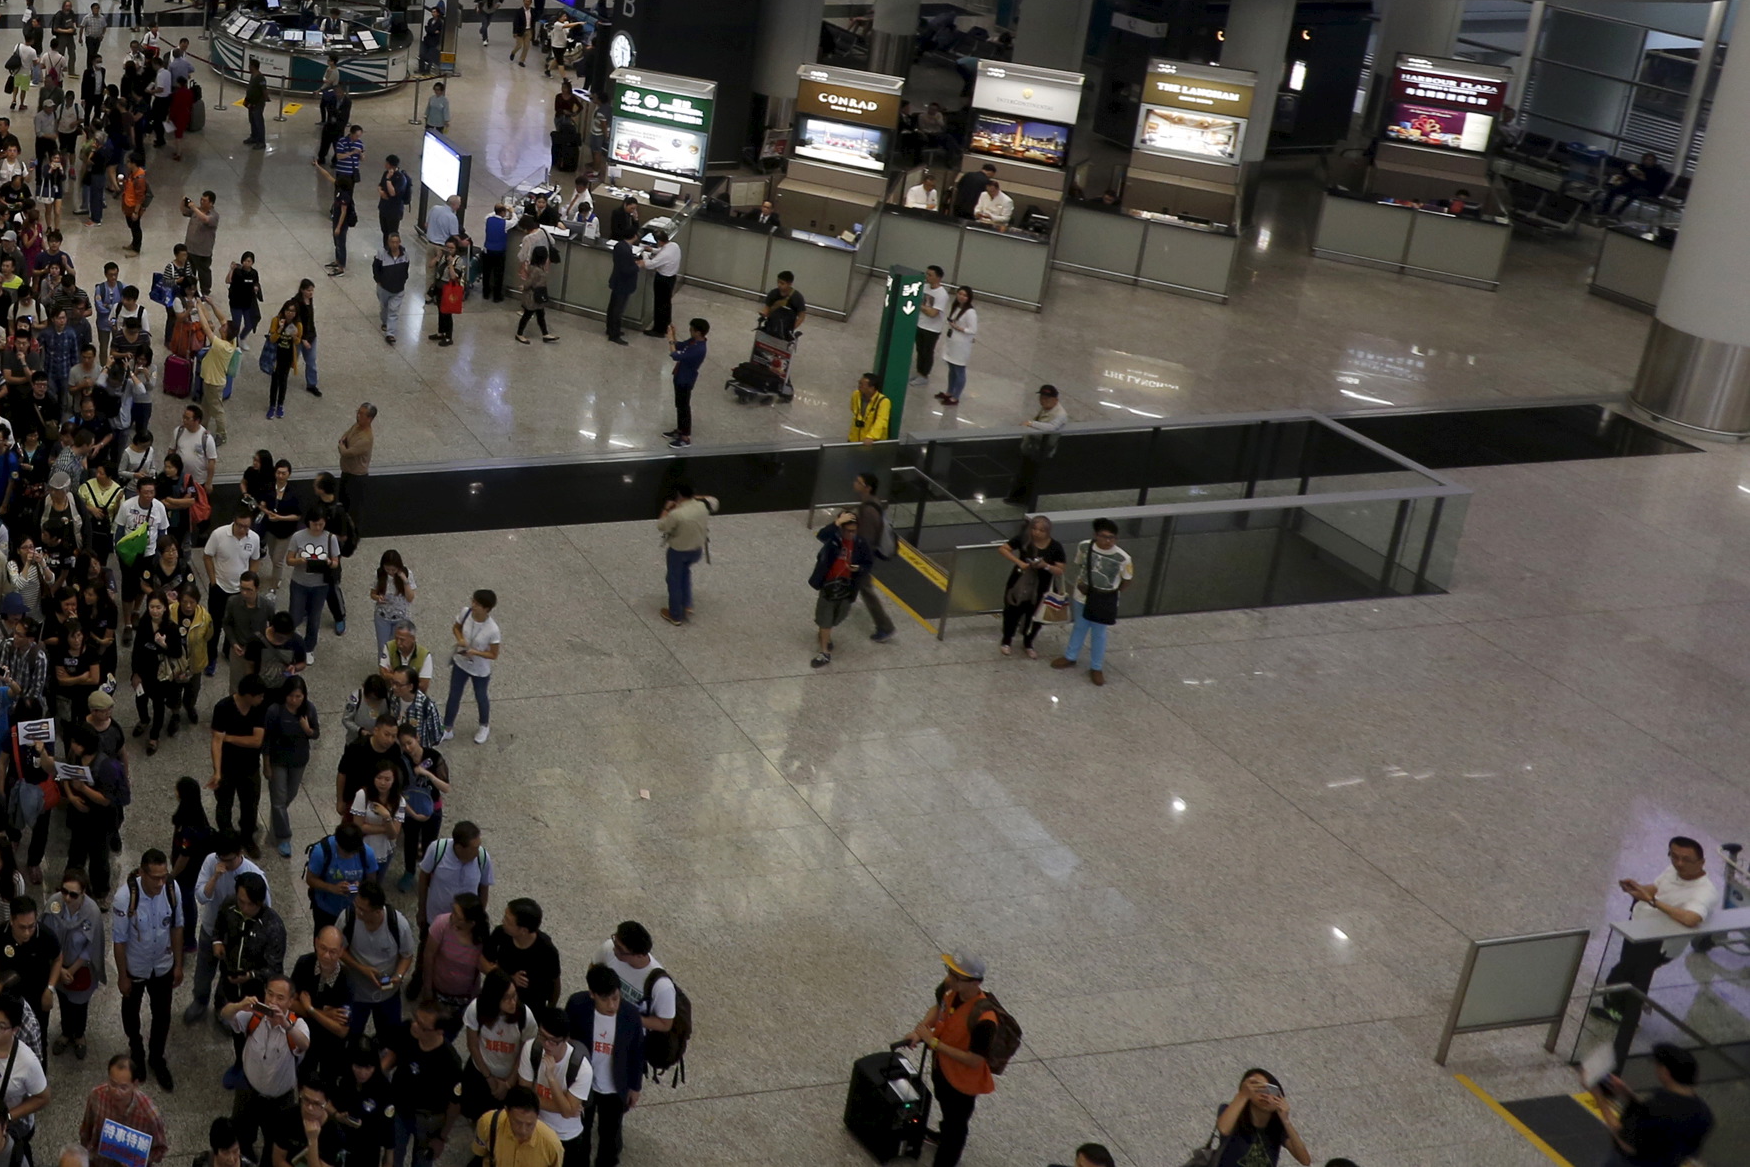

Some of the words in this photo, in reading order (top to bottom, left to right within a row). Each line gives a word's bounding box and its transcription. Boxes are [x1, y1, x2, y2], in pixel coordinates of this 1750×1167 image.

[1157, 81, 1181, 93] THE
[1181, 85, 1240, 101] LANGHAM
[1401, 73, 1458, 87] HARBOUR
[1460, 81, 1498, 93] PLAZA
[818, 92, 878, 111] CONRAD
[103, 1122, 151, 1153] 特事特辦
